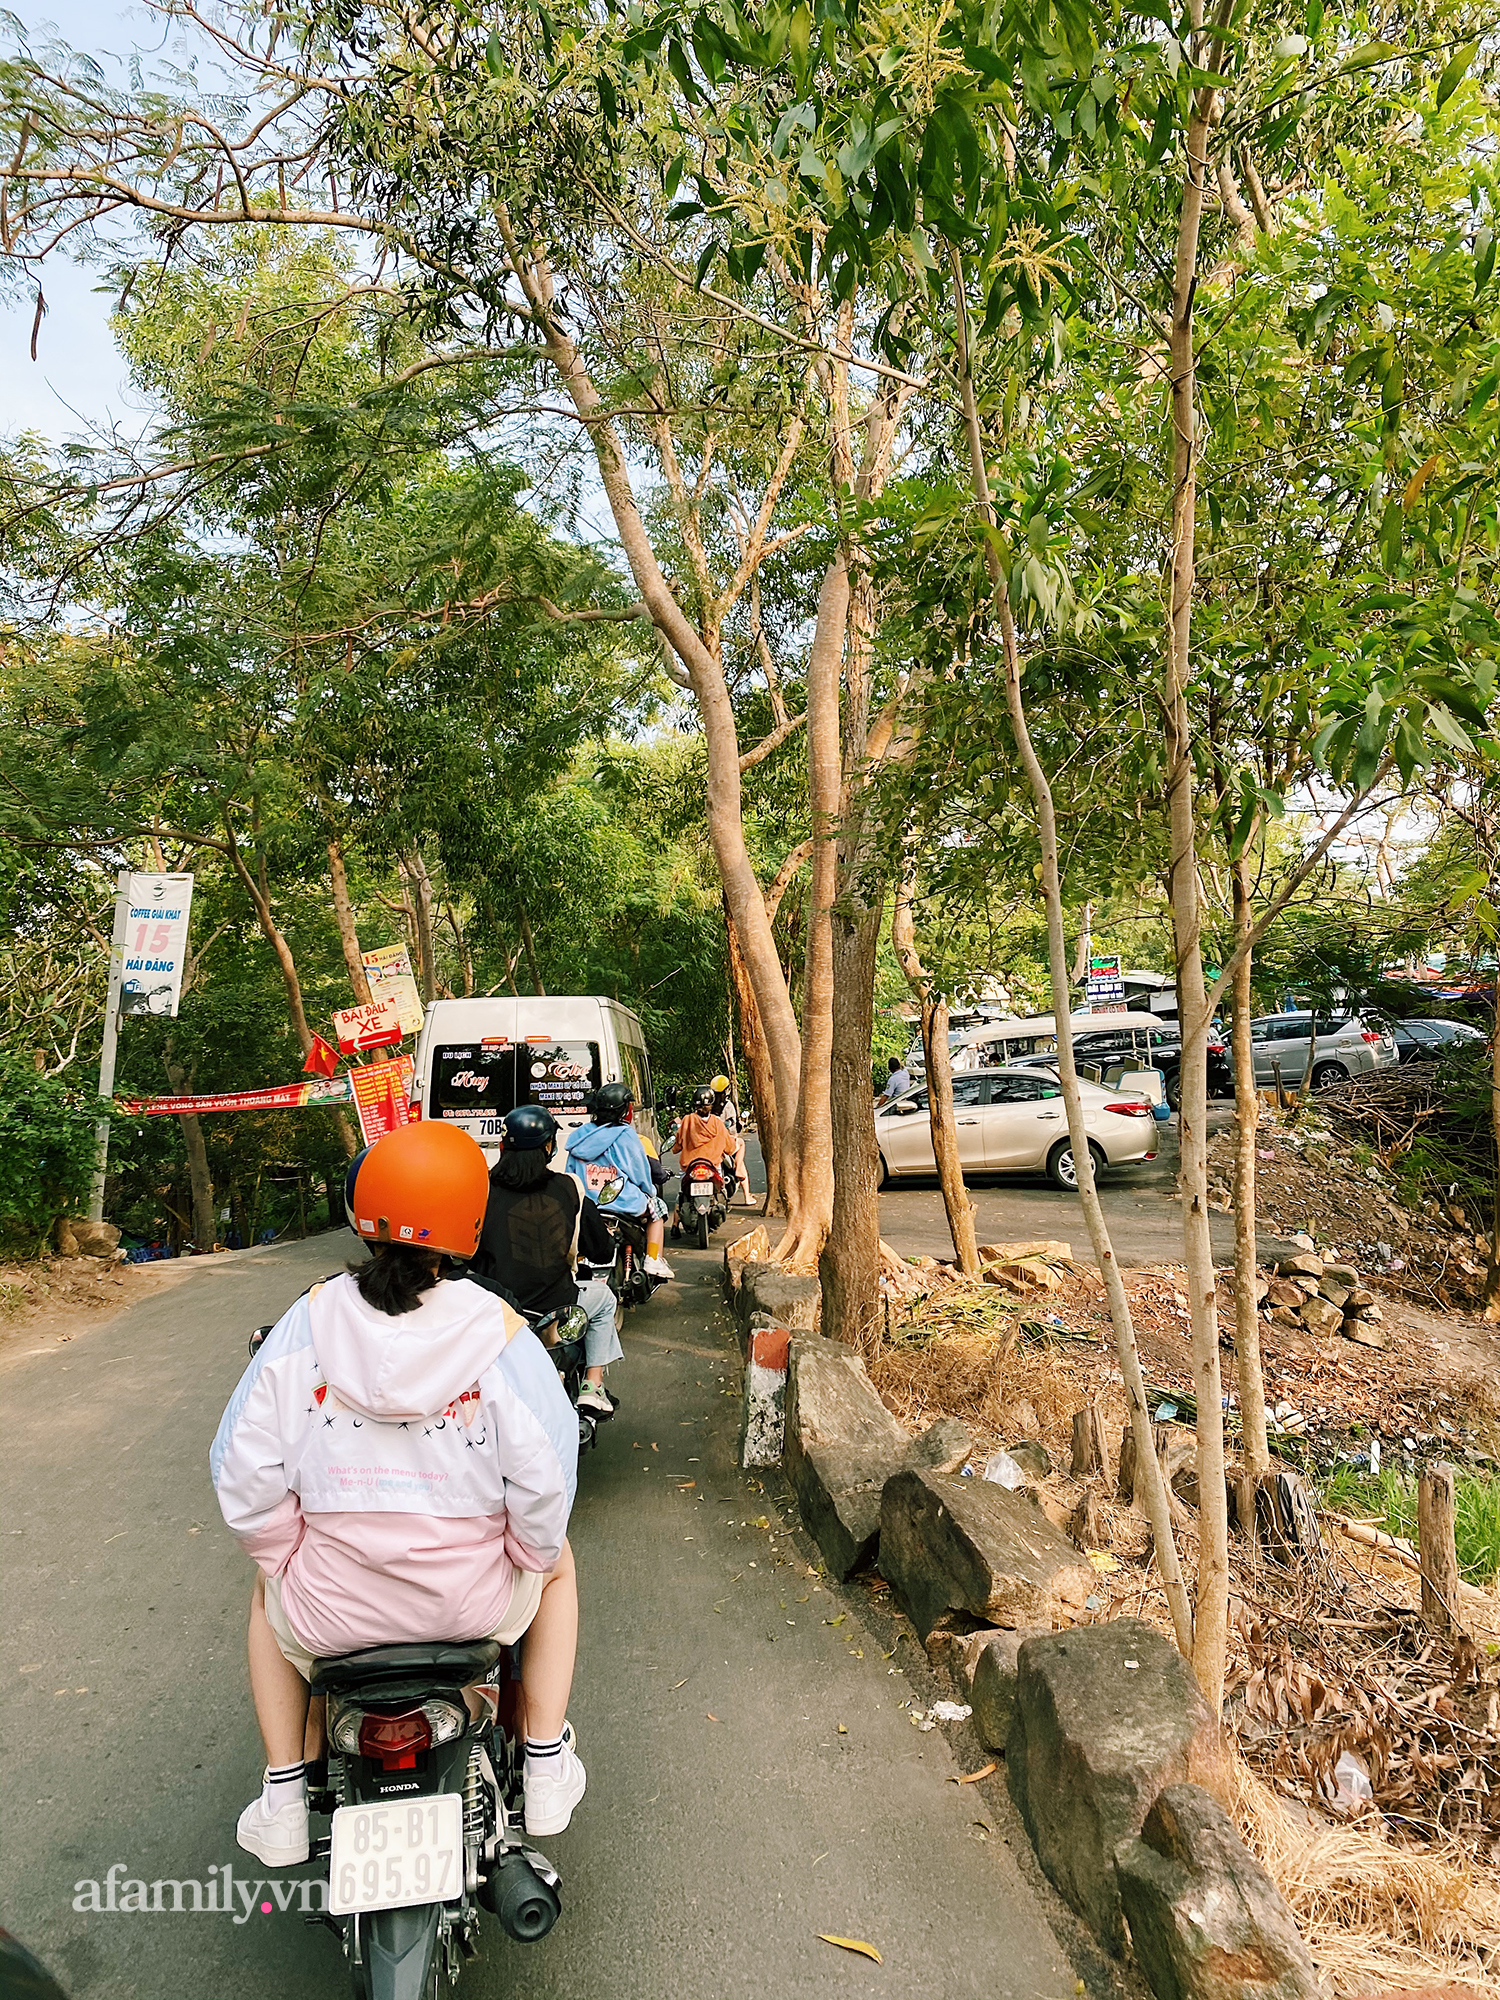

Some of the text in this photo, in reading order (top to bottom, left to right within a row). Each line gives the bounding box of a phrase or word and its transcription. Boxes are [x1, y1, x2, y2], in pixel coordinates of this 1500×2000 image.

[130, 908, 152, 919] COFFEE
[134, 924, 172, 954] 15
[126, 956, 174, 972] HẢI ĐĂNG
[365, 954, 379, 965] 15
[341, 1006, 363, 1024] BÃI
[357, 1016, 383, 1035] XE
[451, 1071, 490, 1092] Huy
[327, 1466, 358, 1475] What's
[374, 1466, 389, 1474] the
[391, 1468, 417, 1478] menu
[418, 1471, 449, 1482] today?
[339, 1477, 373, 1486] Me-n-U
[380, 1782, 420, 1793] HONDA
[354, 1805, 438, 1854] 85-B1
[339, 1850, 452, 1904] 695.97
